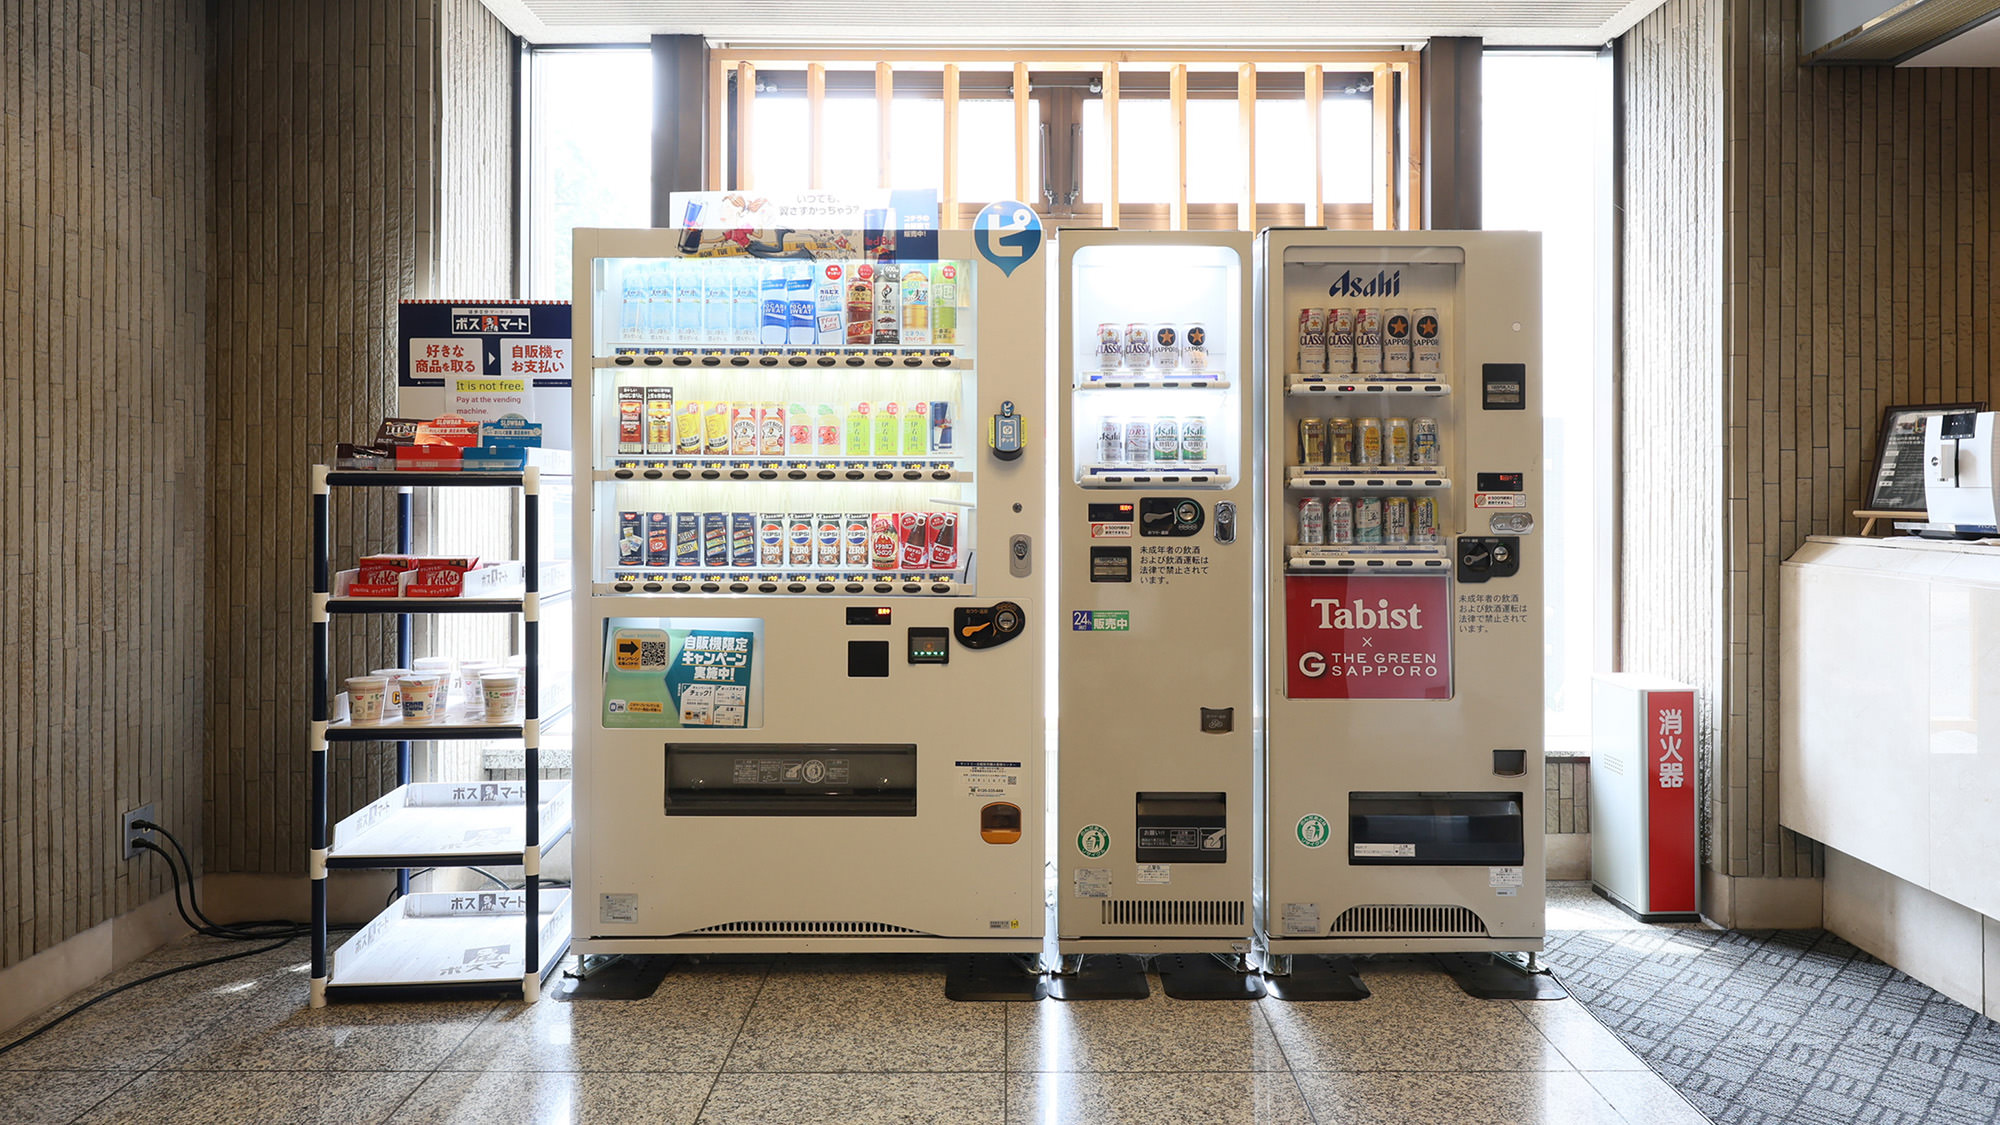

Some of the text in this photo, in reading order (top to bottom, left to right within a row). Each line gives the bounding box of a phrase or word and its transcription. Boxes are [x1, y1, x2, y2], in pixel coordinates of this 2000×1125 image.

[1328, 270, 1400, 297] Asahi
[456, 318, 527, 331] ボス マート
[426, 344, 564, 359] 好きな 自販機で
[416, 359, 565, 374] 商品を取る お支払い
[456, 381, 465, 391] It
[467, 381, 476, 391] is
[479, 381, 497, 391] not
[499, 381, 524, 391] free.
[456, 396, 469, 404] Pay
[492, 396, 521, 404] vending
[1140, 546, 1201, 554] 未成年者の飲酒
[1140, 556, 1209, 564] および飲酒運転は
[1140, 566, 1209, 574] 法律で禁止されて
[1140, 576, 1170, 584] います。
[1459, 594, 1519, 603] 未成年者の飲酒
[1310, 598, 1423, 629] Tabist
[1459, 604, 1527, 613] および飲酒運転は
[1093, 618, 1128, 630] 販売中
[1459, 614, 1527, 623] 法律で禁止されて
[1459, 625, 1489, 633] います。
[684, 635, 748, 651] 自販機限定
[681, 652, 747, 666] キャンペーン
[1298, 651, 1436, 677] G THE GREEN
[694, 667, 735, 680] 実施中!
[1331, 665, 1437, 677] SAPPORO
[1659, 709, 1684, 788] 消火器
[453, 786, 477, 800] ボス
[451, 896, 475, 910] ボス
